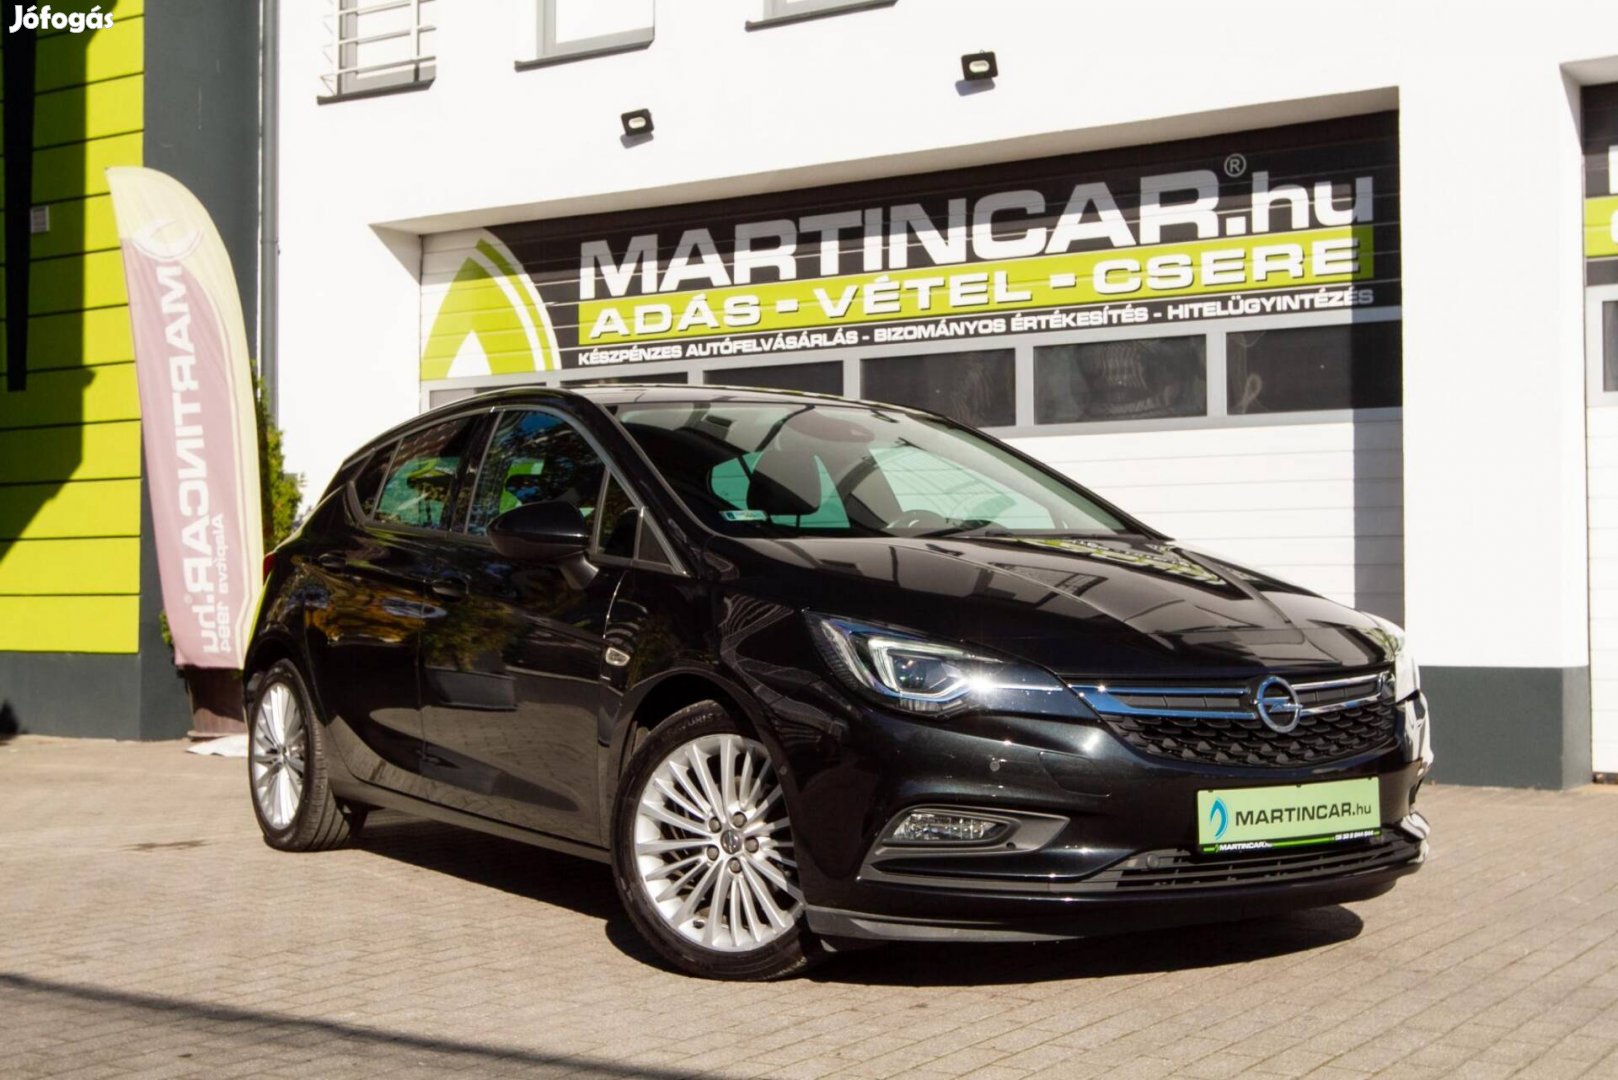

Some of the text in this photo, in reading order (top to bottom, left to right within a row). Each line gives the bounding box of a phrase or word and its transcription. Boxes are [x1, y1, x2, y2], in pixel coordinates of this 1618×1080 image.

[578, 344, 683, 366] KÉSZPÉNZES
[686, 327, 859, 358] AUTÓFELVÁSÁRLÁS
[874, 318, 1007, 343] BIZOMÁNYOS
[1011, 304, 1149, 332] ÉRTÉKESÍTÉS
[1167, 286, 1374, 320] HITELÜGYINTÉZÉS
[589, 293, 761, 339] ADÁS
[813, 271, 1032, 318] VÉTEL
[1093, 238, 1360, 294] CSERE
[1235, 802, 1372, 826] MARTINCAR.hu
